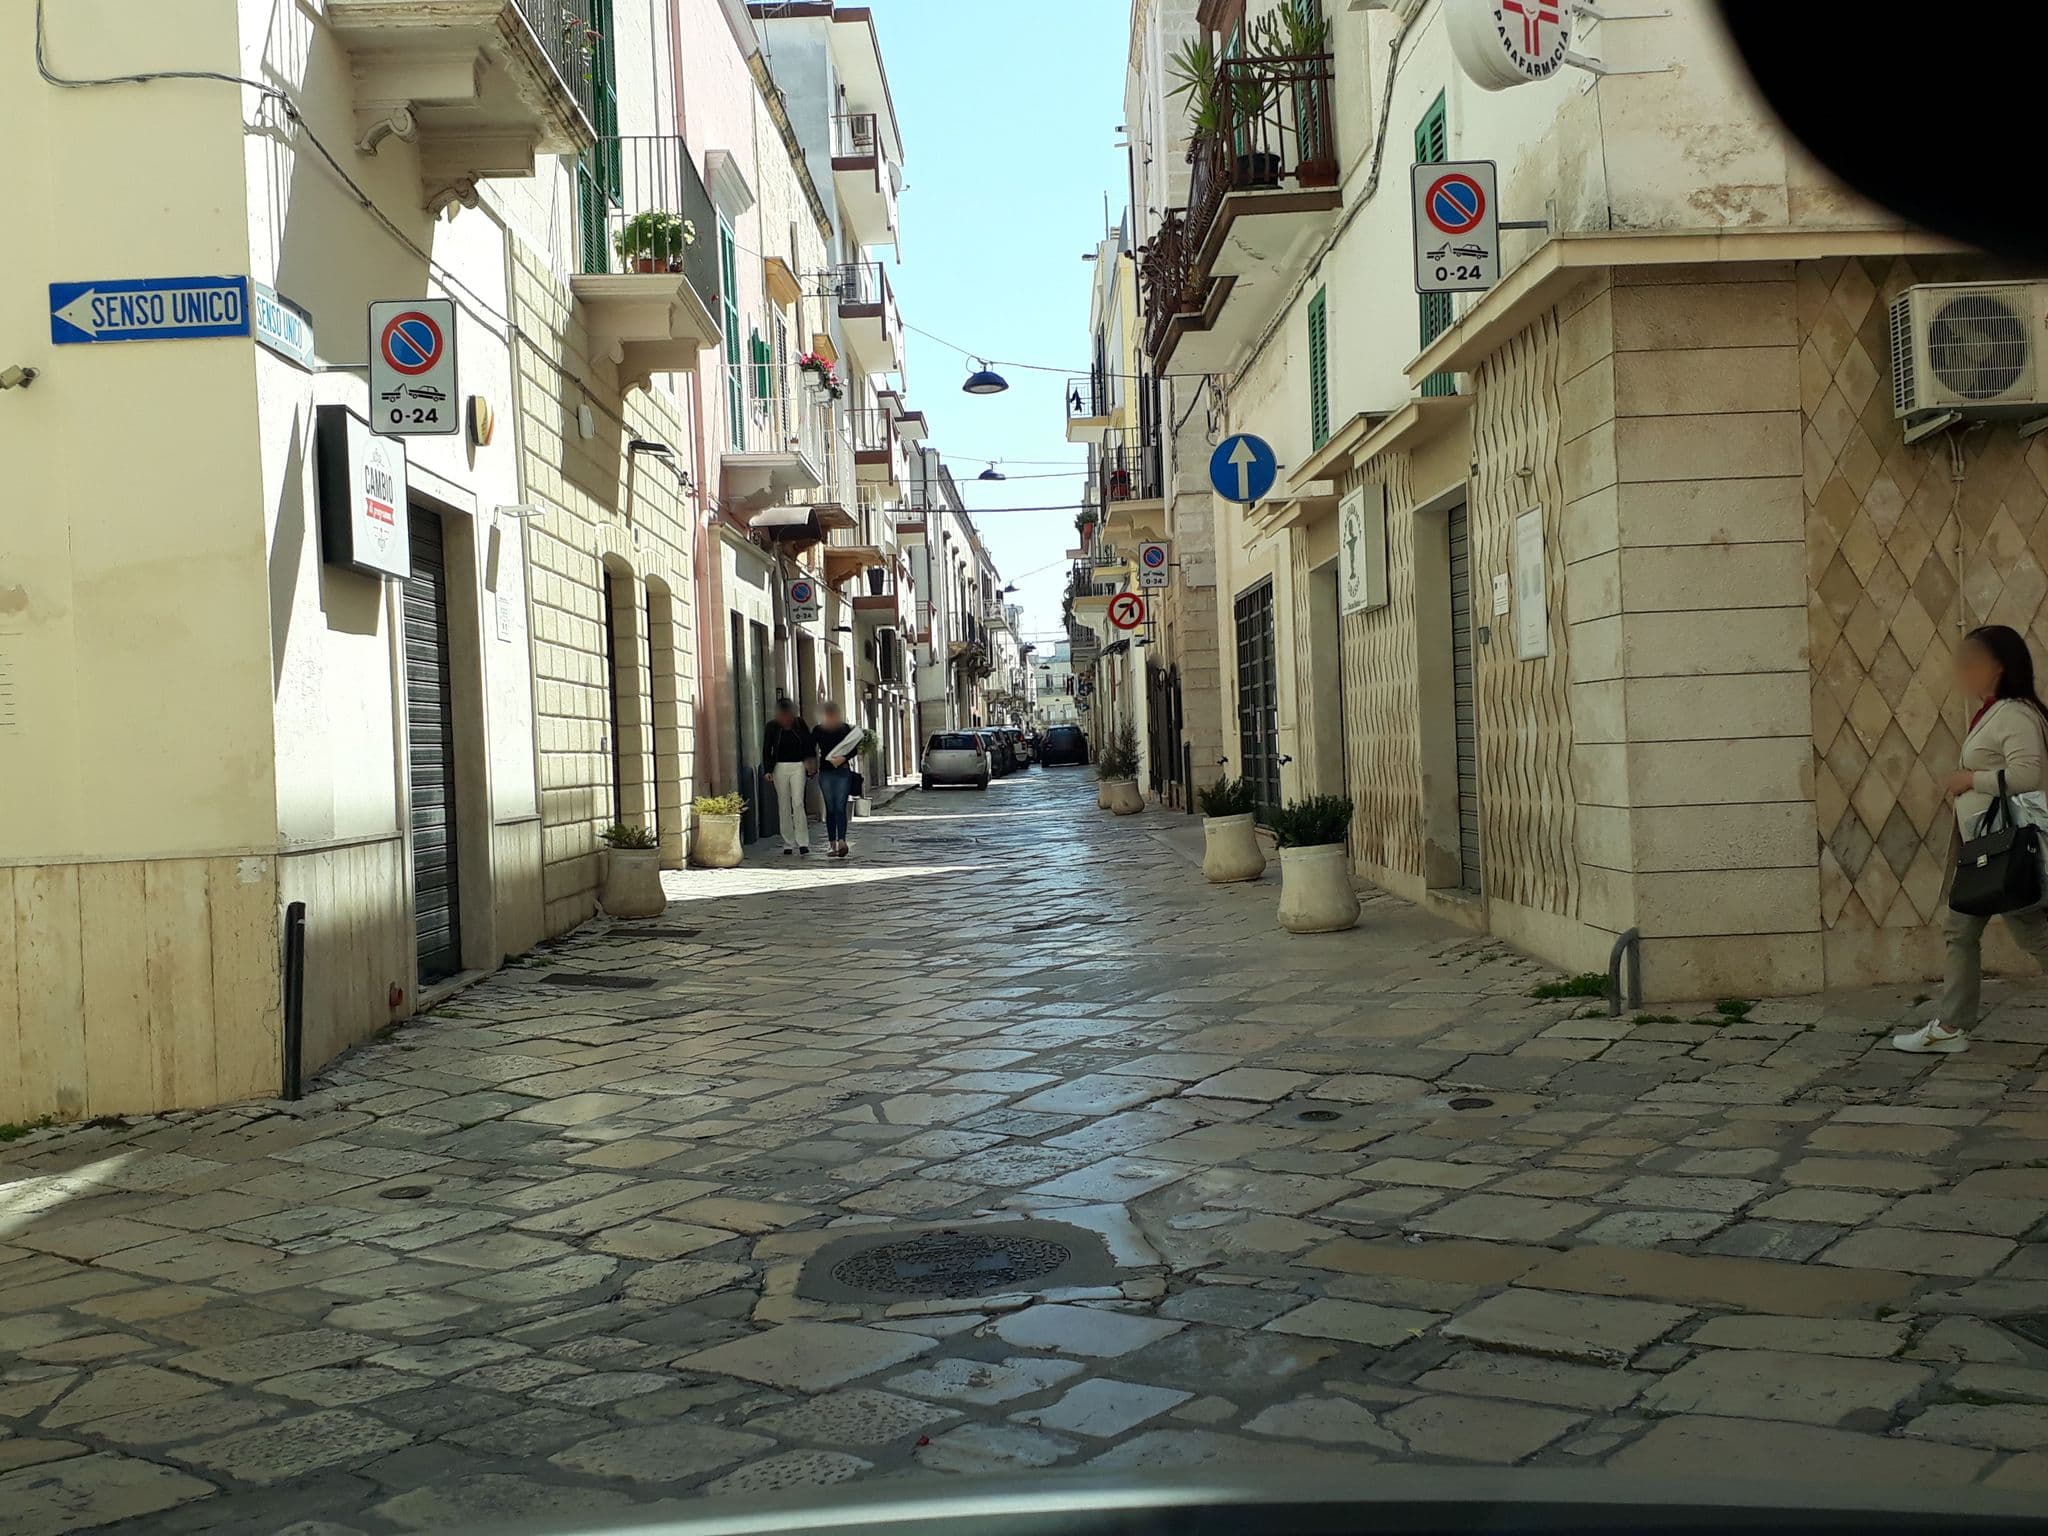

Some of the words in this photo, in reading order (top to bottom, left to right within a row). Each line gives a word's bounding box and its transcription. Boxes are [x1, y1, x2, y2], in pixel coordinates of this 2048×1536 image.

[1494, 9, 1569, 77] PARAFARMACIA
[1435, 265, 1482, 281] 0-24
[91, 294, 164, 328] SENSO
[172, 290, 239, 324] UNICO
[256, 295, 281, 337] SENSO
[283, 309, 303, 350] UNICO
[390, 408, 439, 424] 0-24
[364, 464, 394, 504] CAMBIO
